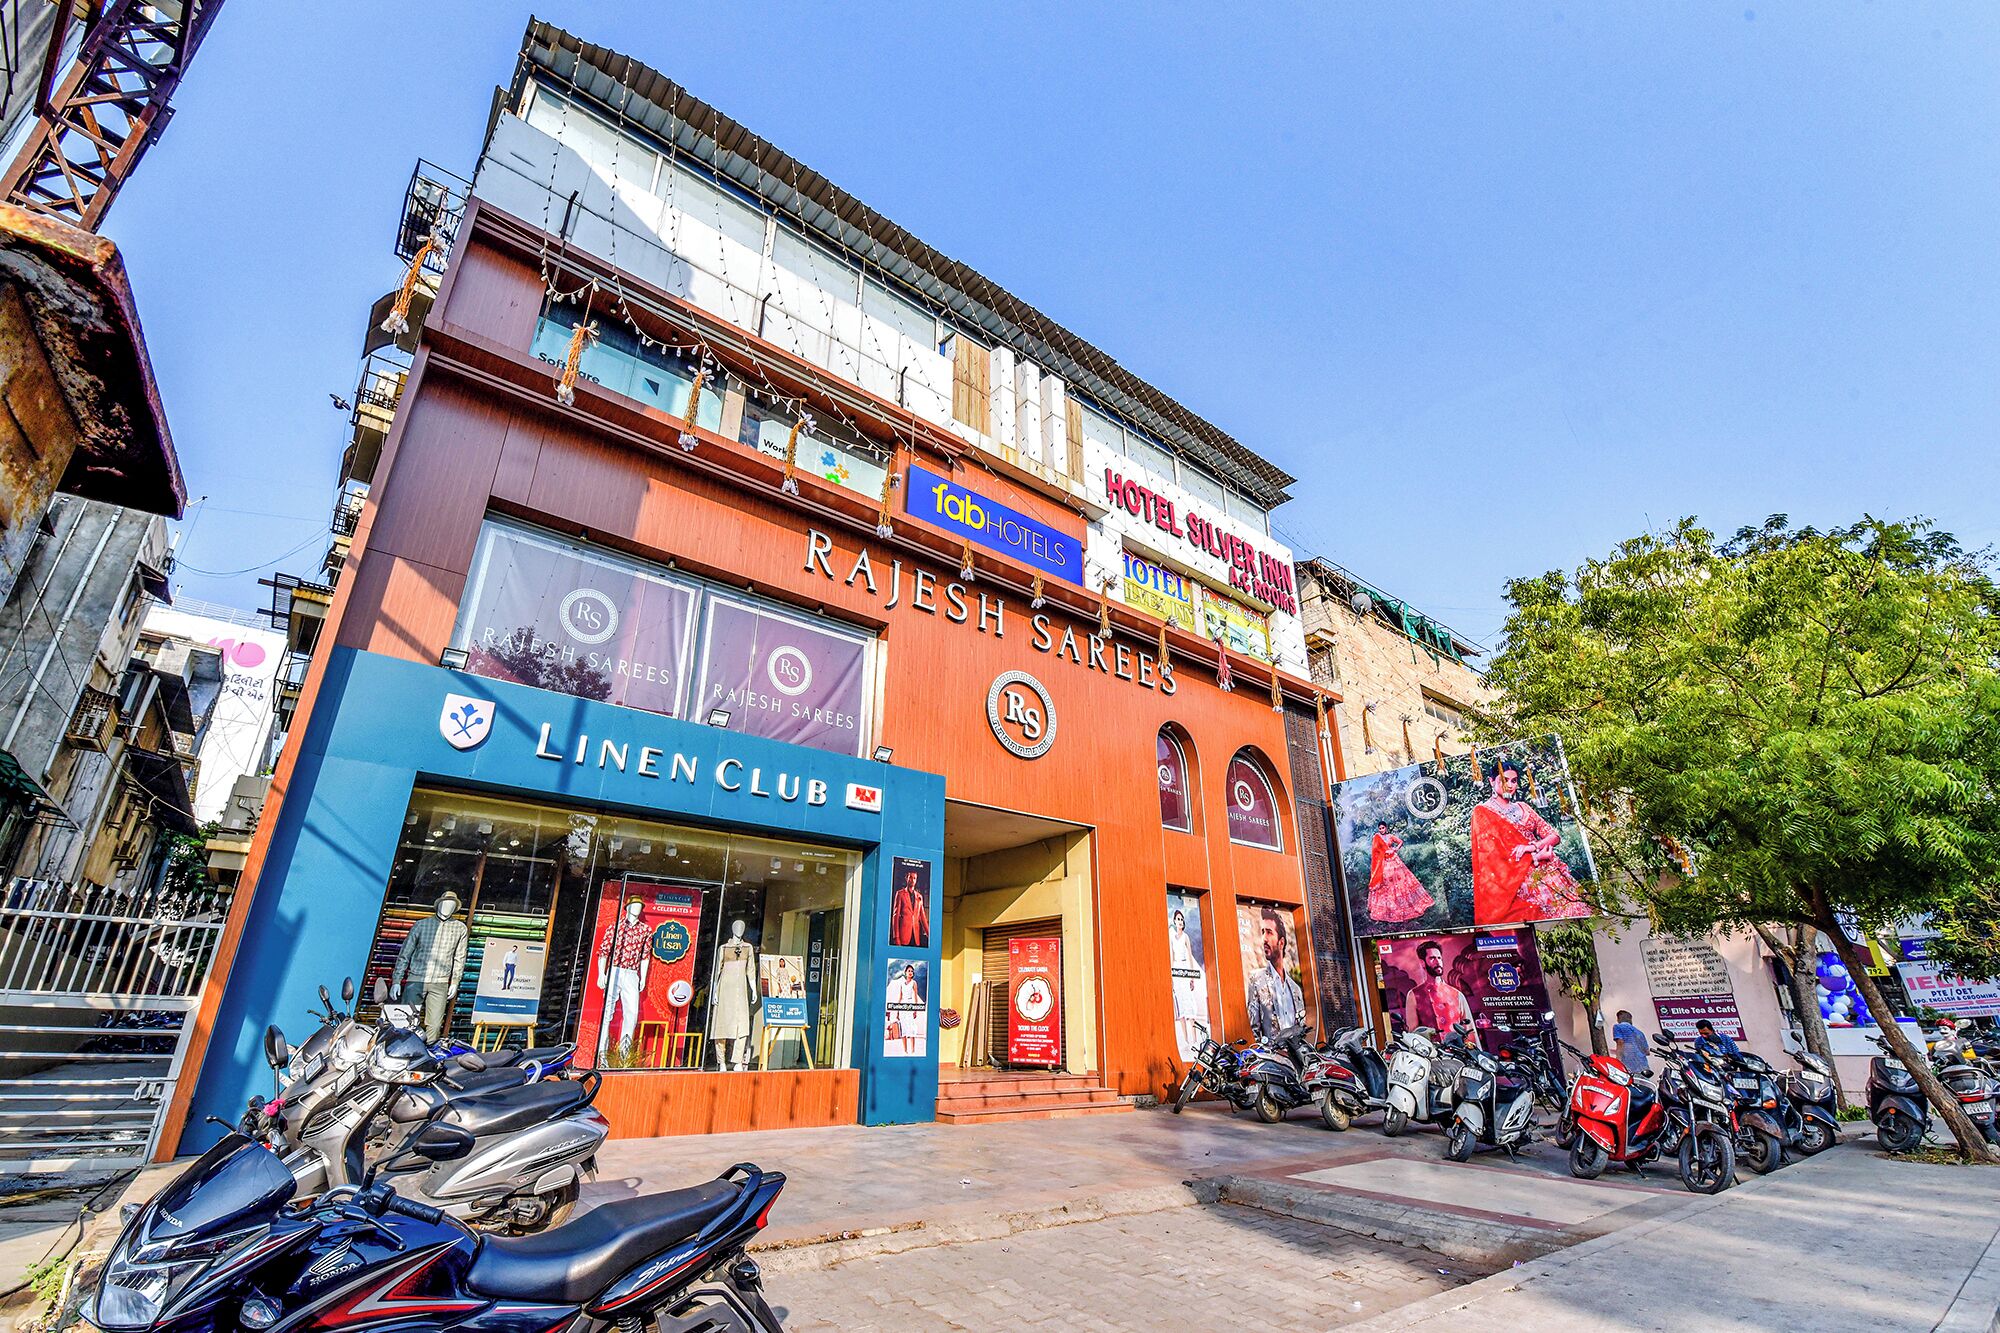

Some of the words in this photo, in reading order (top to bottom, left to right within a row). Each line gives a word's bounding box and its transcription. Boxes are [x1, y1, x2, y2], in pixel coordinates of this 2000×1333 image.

[538, 351, 601, 385] Softare
[931, 483, 1066, 567] fabHOTELS
[1105, 467, 1183, 538] HOTEL
[1186, 512, 1258, 578] SILVER
[1258, 551, 1294, 594] INN
[804, 527, 1005, 638] RAJESH
[1031, 613, 1178, 696] SAREES
[1252, 577, 1297, 618] ROOMS
[576, 602, 602, 630] RS
[482, 626, 575, 663] RAJESH
[588, 652, 670, 685] SAREES
[779, 657, 800, 683] RS
[713, 683, 782, 713] RAJESH
[791, 702, 854, 730] SAREES
[1003, 690, 1042, 740] RS
[536, 722, 698, 784] LINEN
[715, 758, 828, 807] CLUB
[1415, 789, 1436, 807] RS
[661, 930, 683, 940] Linen
[1931, 989, 1948, 997] PTE
[1955, 987, 1973, 995] OET
[1962, 992, 1998, 1001] GROOMING
[1671, 1007, 1690, 1015] Elite
[1690, 1006, 1706, 1014] Tea
[1716, 1005, 1737, 1013] Café
[159, 1208, 184, 1228] HONDA
[309, 1262, 360, 1287] HONDA
